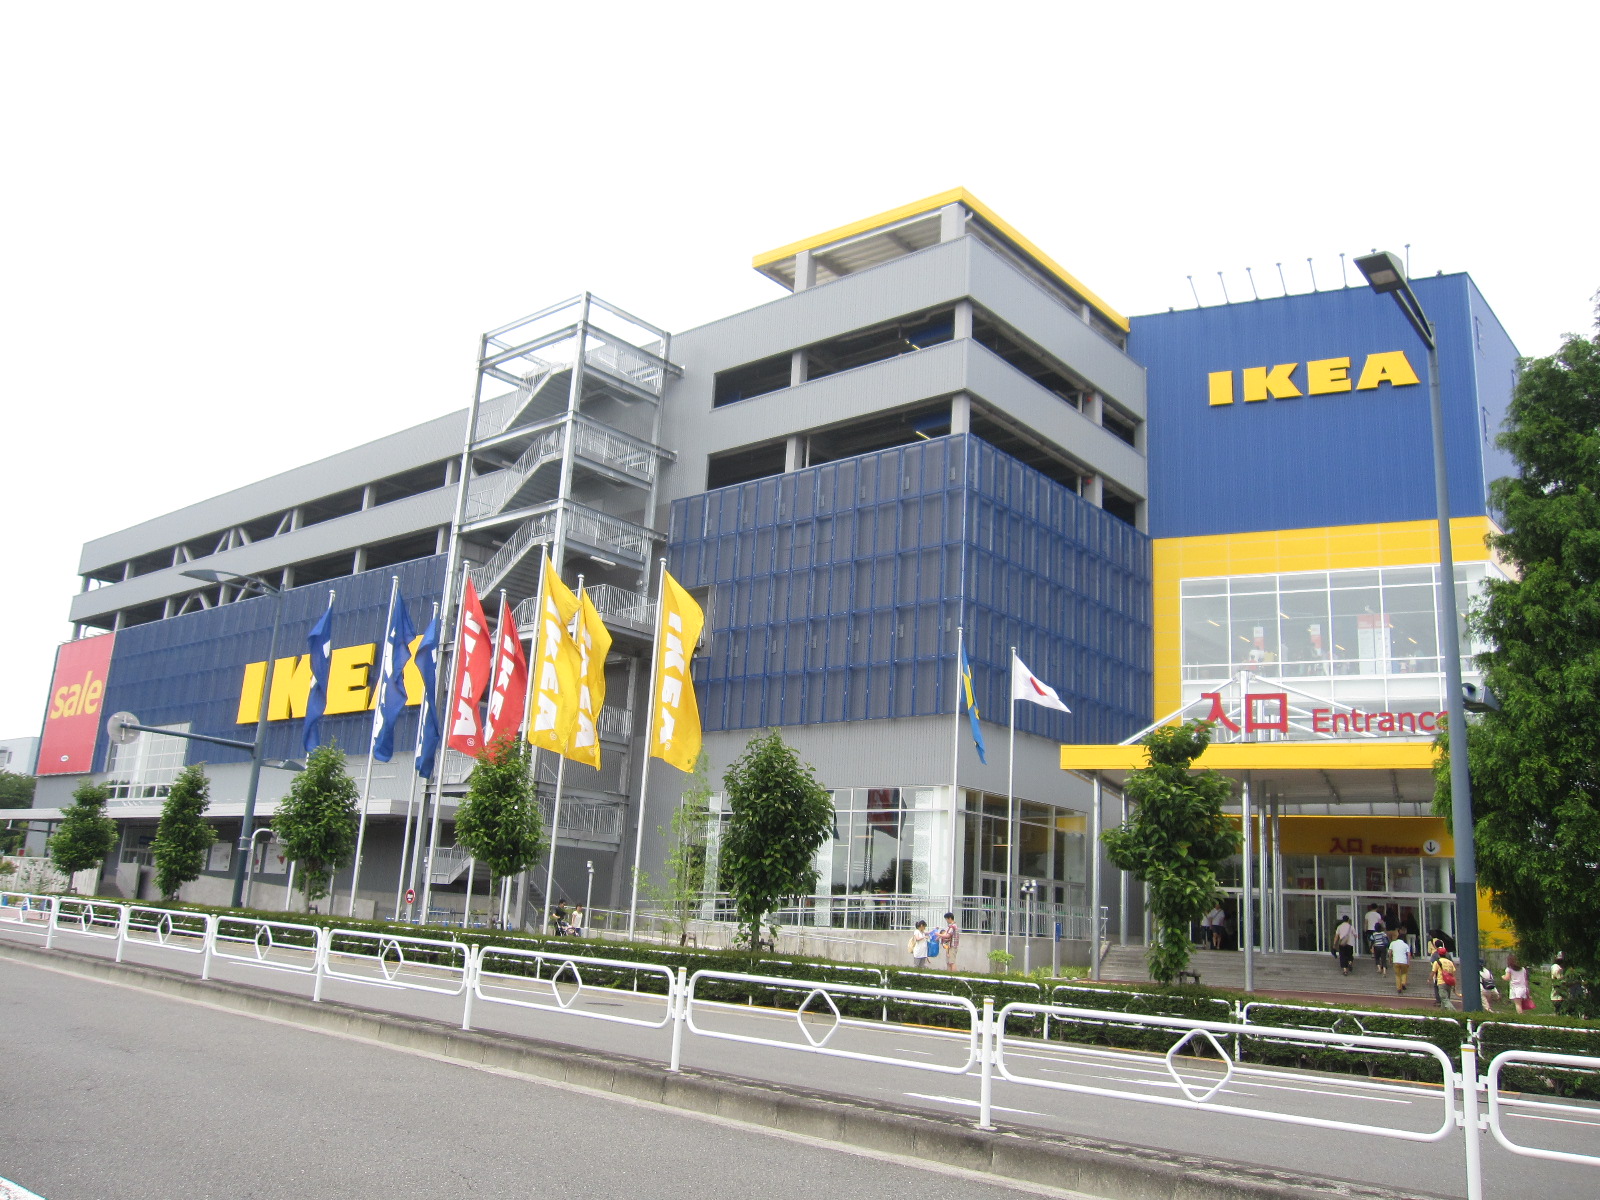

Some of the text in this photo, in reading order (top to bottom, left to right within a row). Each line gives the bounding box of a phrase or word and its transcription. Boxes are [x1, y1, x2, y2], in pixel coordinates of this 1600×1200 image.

[1208, 350, 1421, 406] IKEA
[533, 595, 562, 732] IKEA
[659, 611, 685, 745] IKEA
[50, 670, 103, 719] sale
[1195, 692, 1288, 734] 入口
[1329, 837, 1363, 853] 入口
